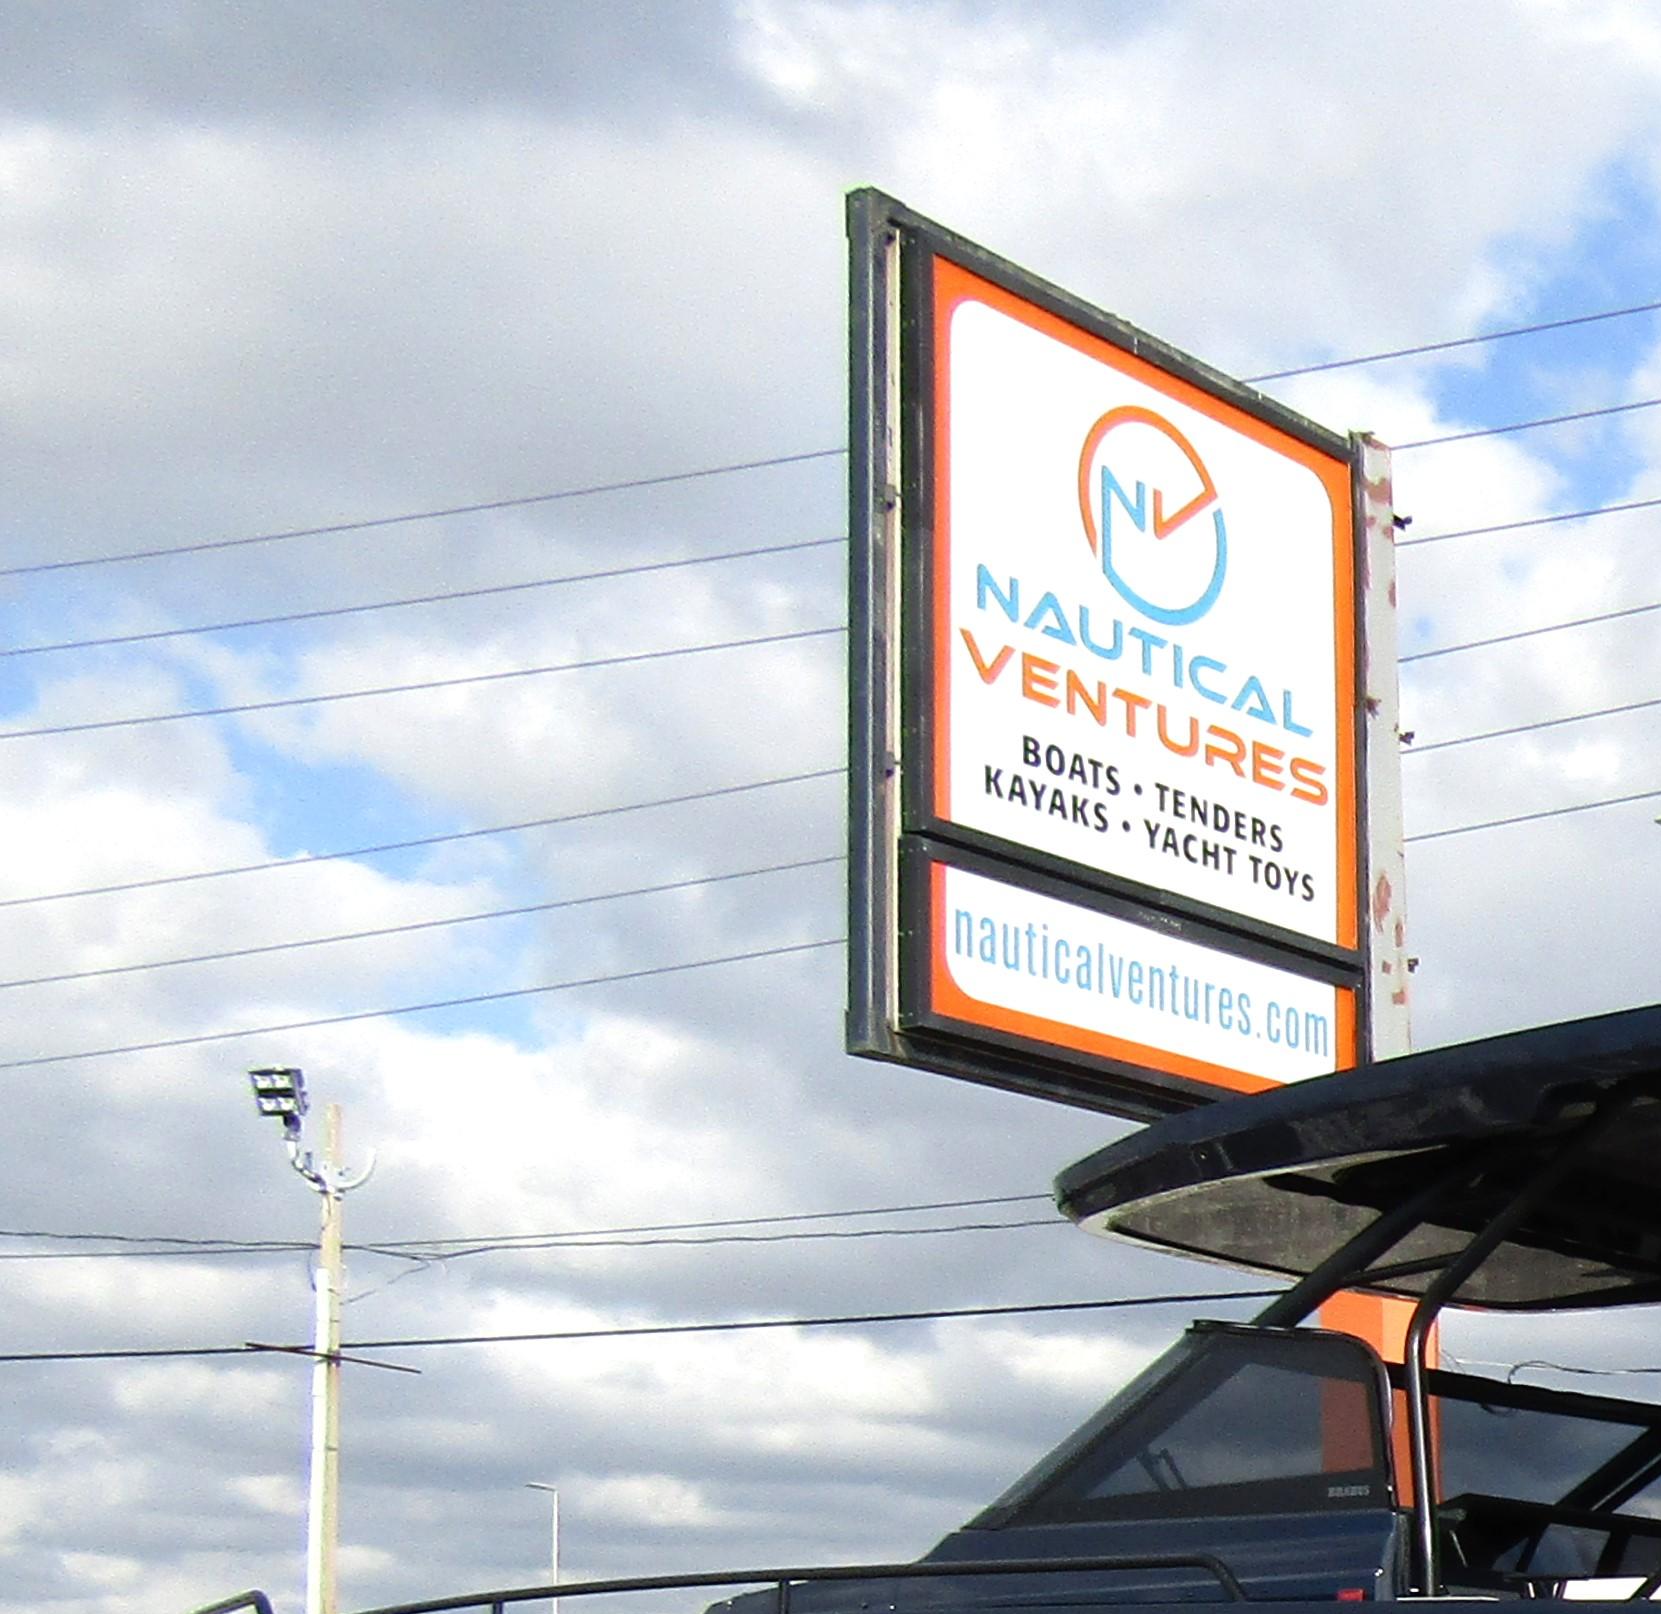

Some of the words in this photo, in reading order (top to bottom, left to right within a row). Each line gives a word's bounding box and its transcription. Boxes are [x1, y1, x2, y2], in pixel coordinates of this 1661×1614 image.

[959, 627, 1328, 806] VENTURES
[976, 563, 1313, 738] NAUTICAL
[983, 764, 1109, 833] KAYAKS
[1143, 819, 1235, 875] YACHT
[1248, 854, 1315, 902] TOYS
[1021, 734, 1121, 796] BOATS
[1154, 782, 1284, 853] TENDERS
[954, 908, 1329, 1057] nauticalventures.com
